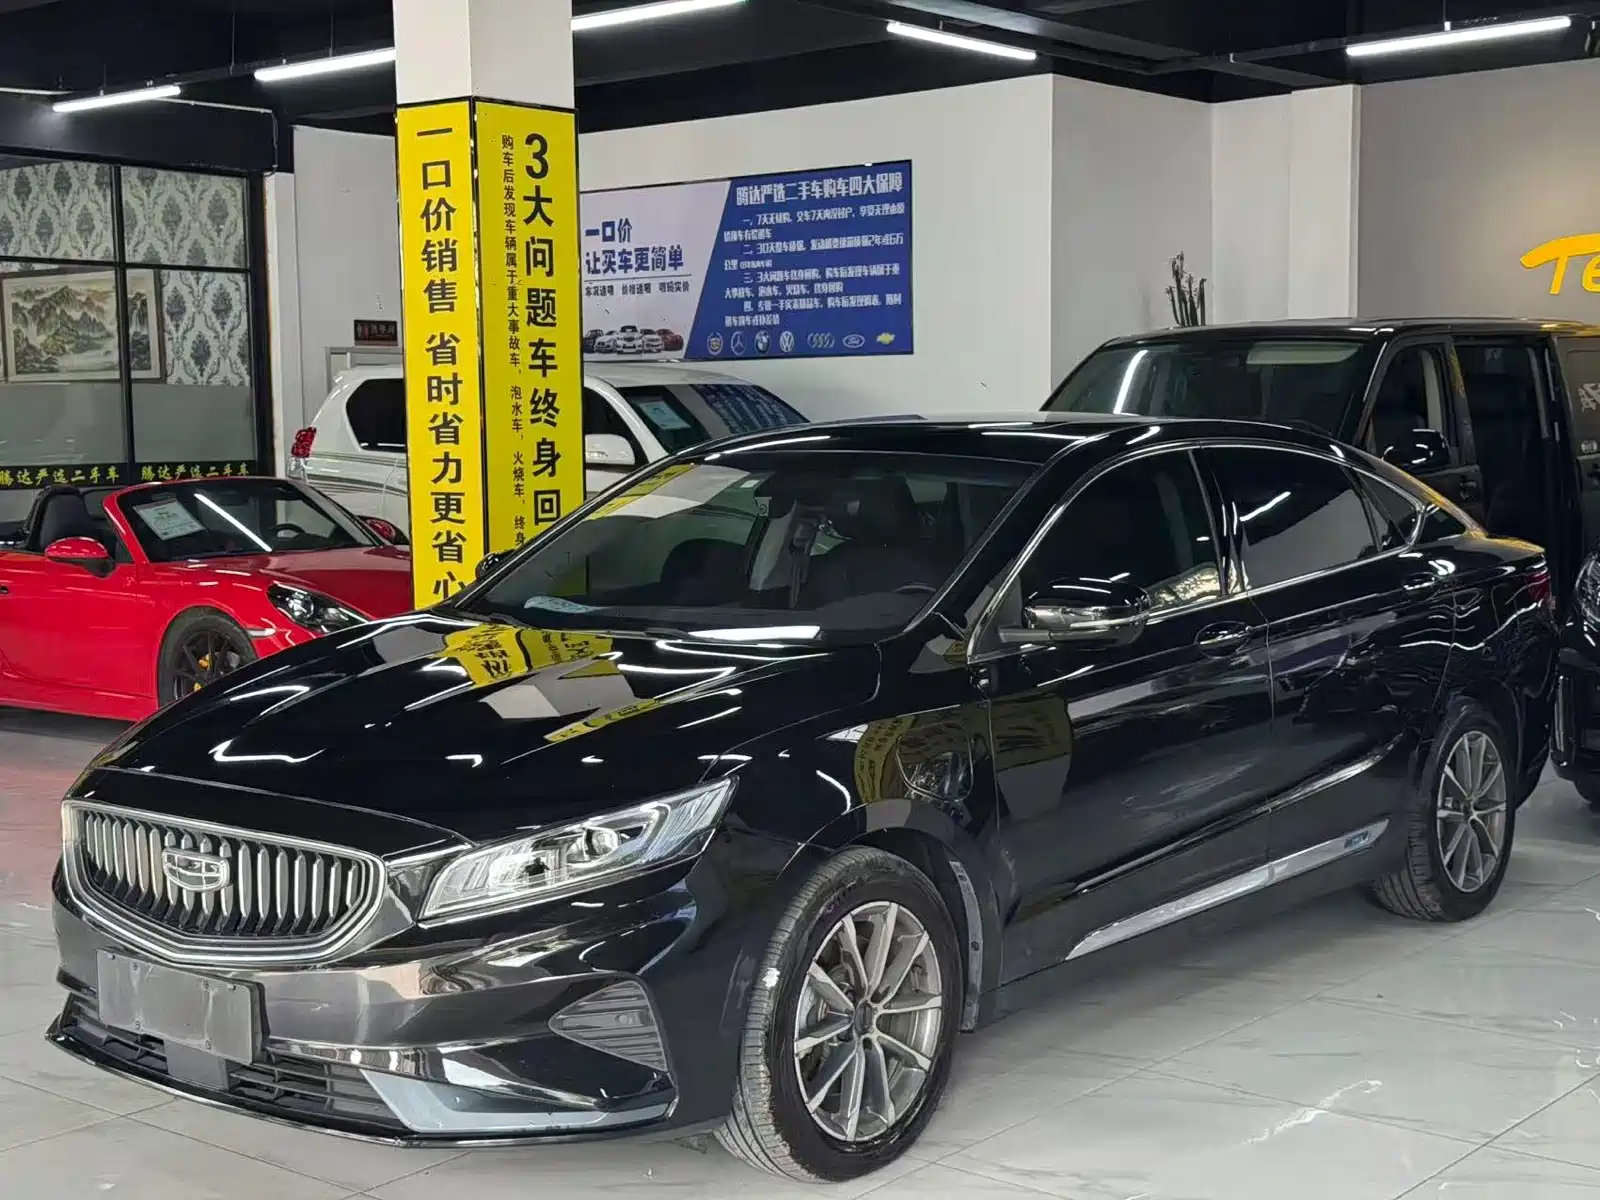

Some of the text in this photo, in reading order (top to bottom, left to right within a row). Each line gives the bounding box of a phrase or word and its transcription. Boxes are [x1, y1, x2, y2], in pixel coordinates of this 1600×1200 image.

[736, 172, 903, 206] 腾达严选二手车购车四大保障
[416, 127, 459, 313] 一口价销售
[585, 217, 632, 243] 一口价
[585, 244, 684, 275] 让买车更简单
[522, 133, 562, 527] 3大问题车终身回
